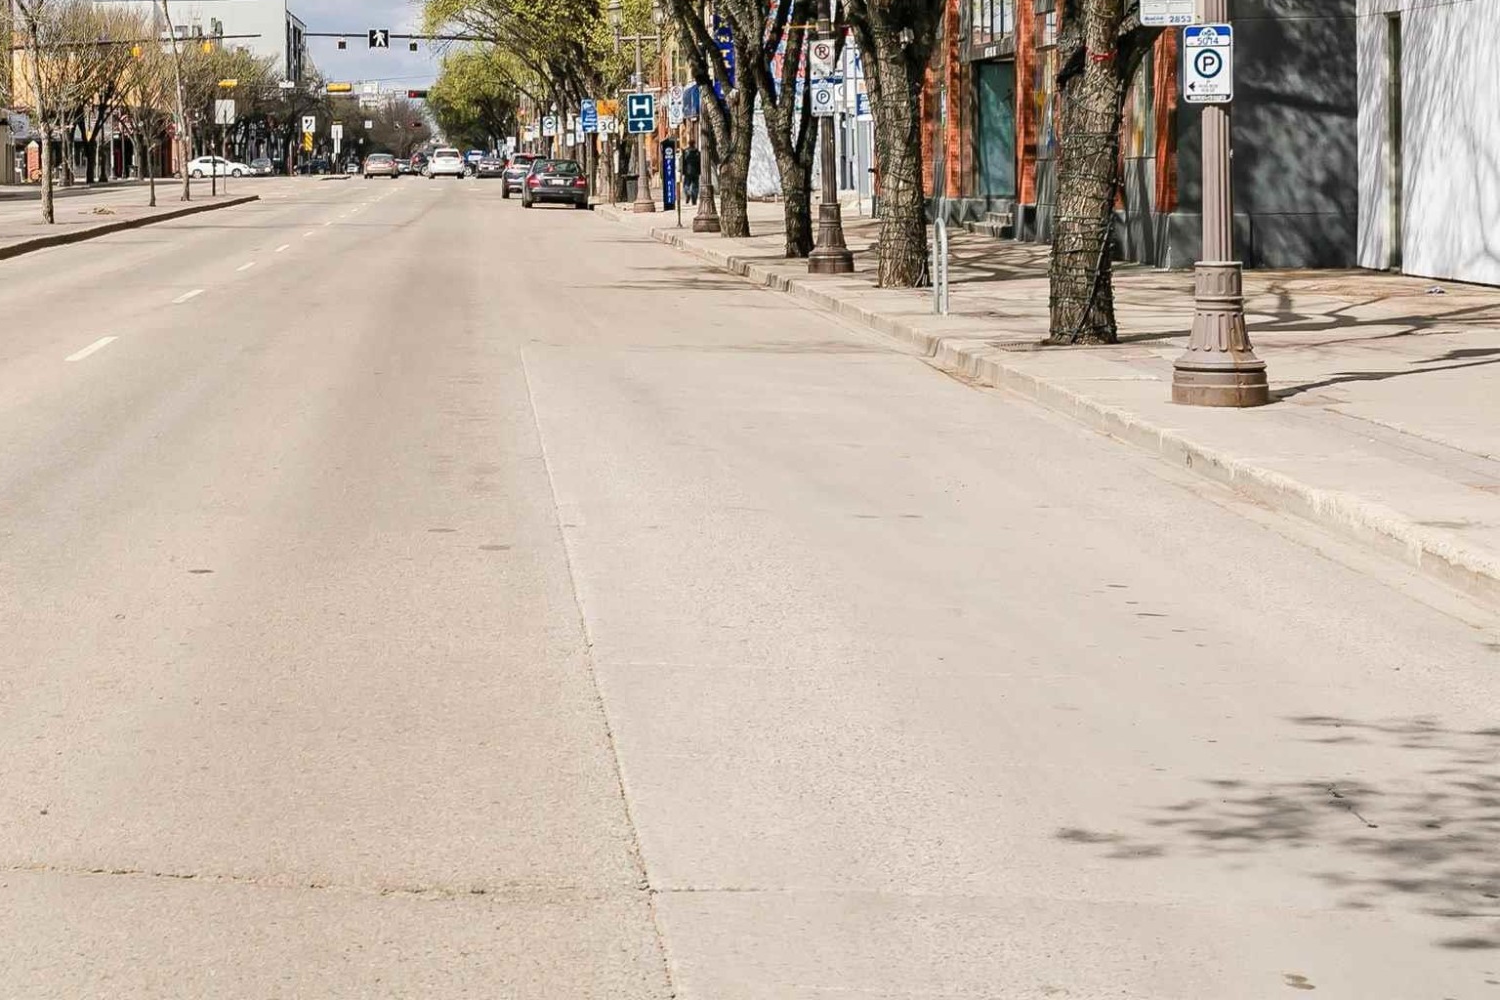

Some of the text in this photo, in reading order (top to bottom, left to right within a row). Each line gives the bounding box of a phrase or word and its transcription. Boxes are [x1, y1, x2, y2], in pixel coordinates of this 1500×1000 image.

[1169, 15, 1192, 24] 2853
[1202, 55, 1215, 72] P
[631, 98, 650, 116] H
